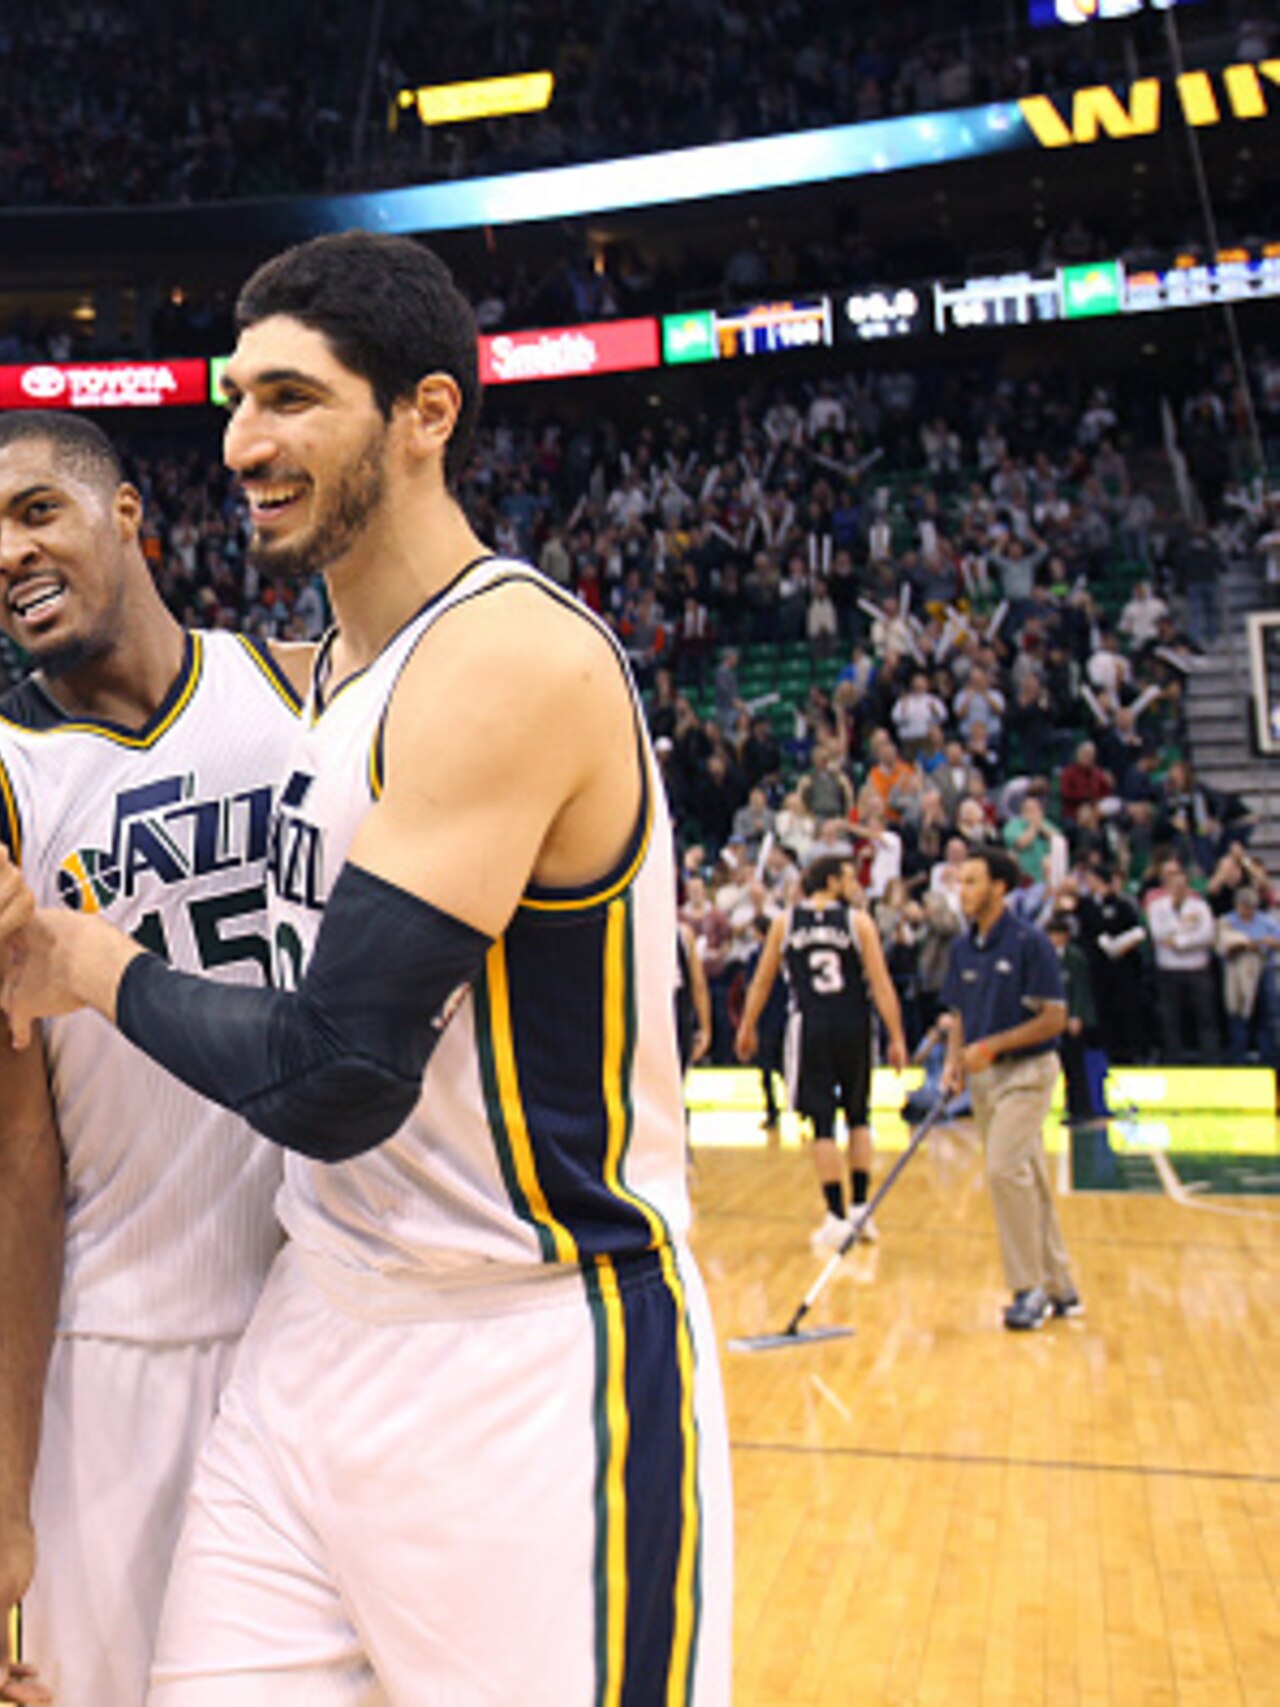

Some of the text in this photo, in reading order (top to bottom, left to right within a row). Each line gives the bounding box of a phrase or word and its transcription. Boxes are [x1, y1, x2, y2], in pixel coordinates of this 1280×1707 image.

[67, 366, 177, 395] TOYOTA
[57, 770, 273, 914] JAZZ
[808, 950, 845, 994] 3
